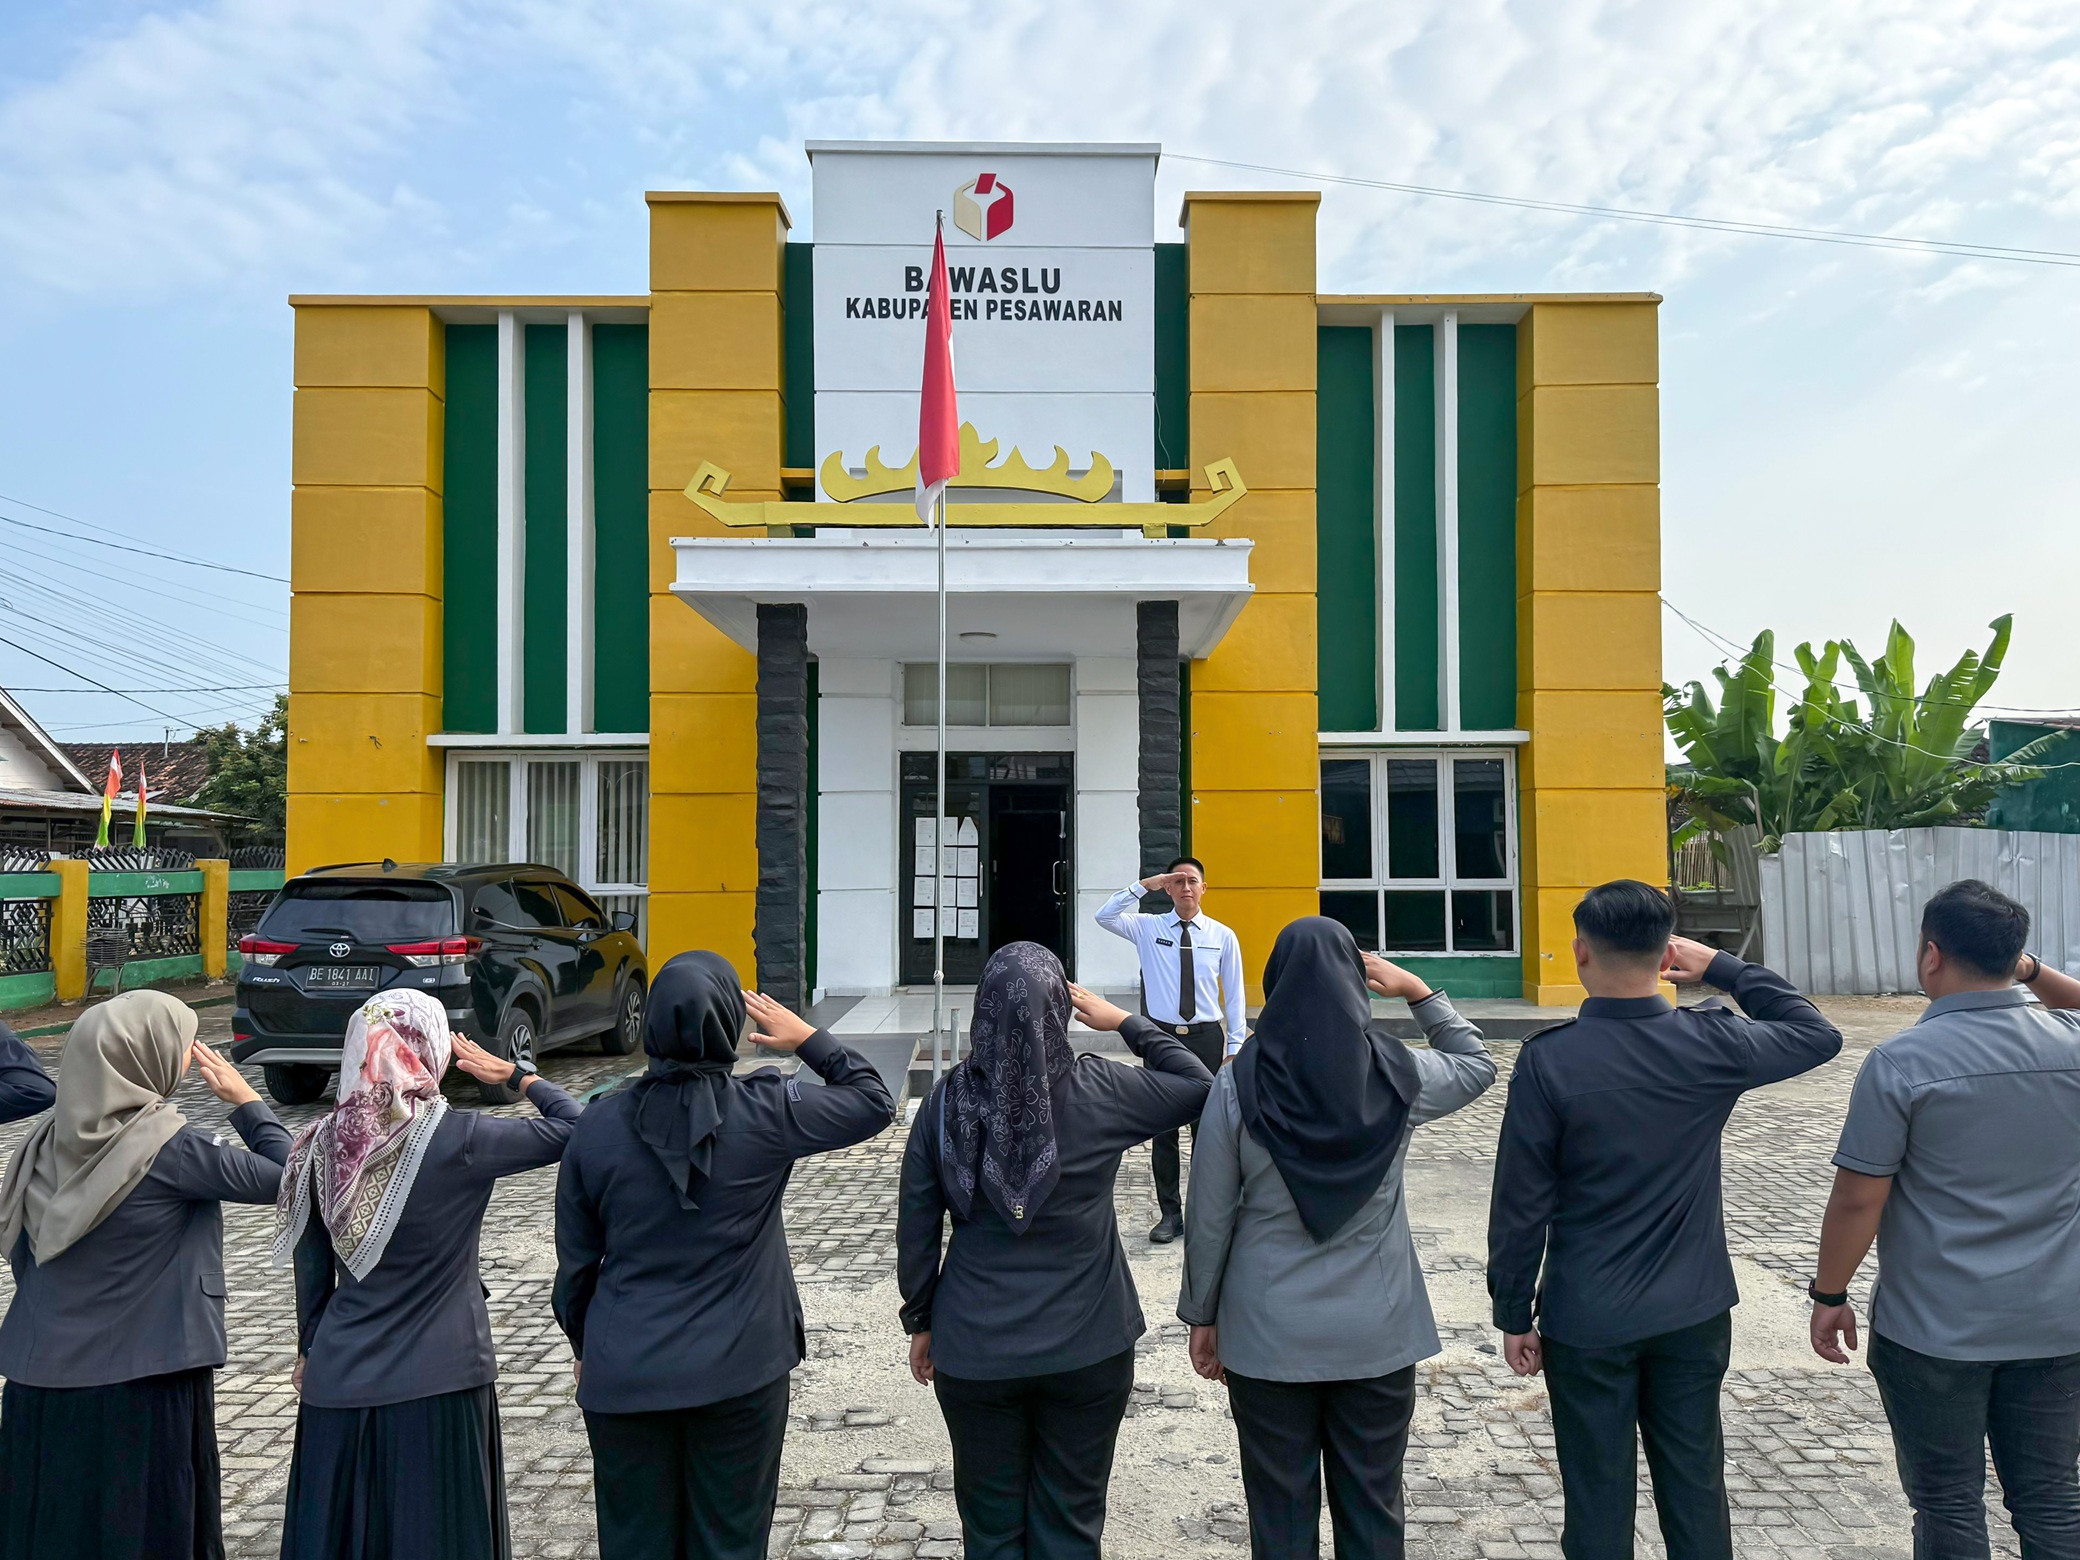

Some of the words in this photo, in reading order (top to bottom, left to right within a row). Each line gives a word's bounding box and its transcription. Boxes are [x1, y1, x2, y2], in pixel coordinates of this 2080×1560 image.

[905, 265, 1060, 294] BWASLU
[986, 300, 1123, 322] PESAWARAN
[252, 976, 281, 984] Rush
[309, 968, 324, 980] BE
[327, 968, 350, 980] 1841
